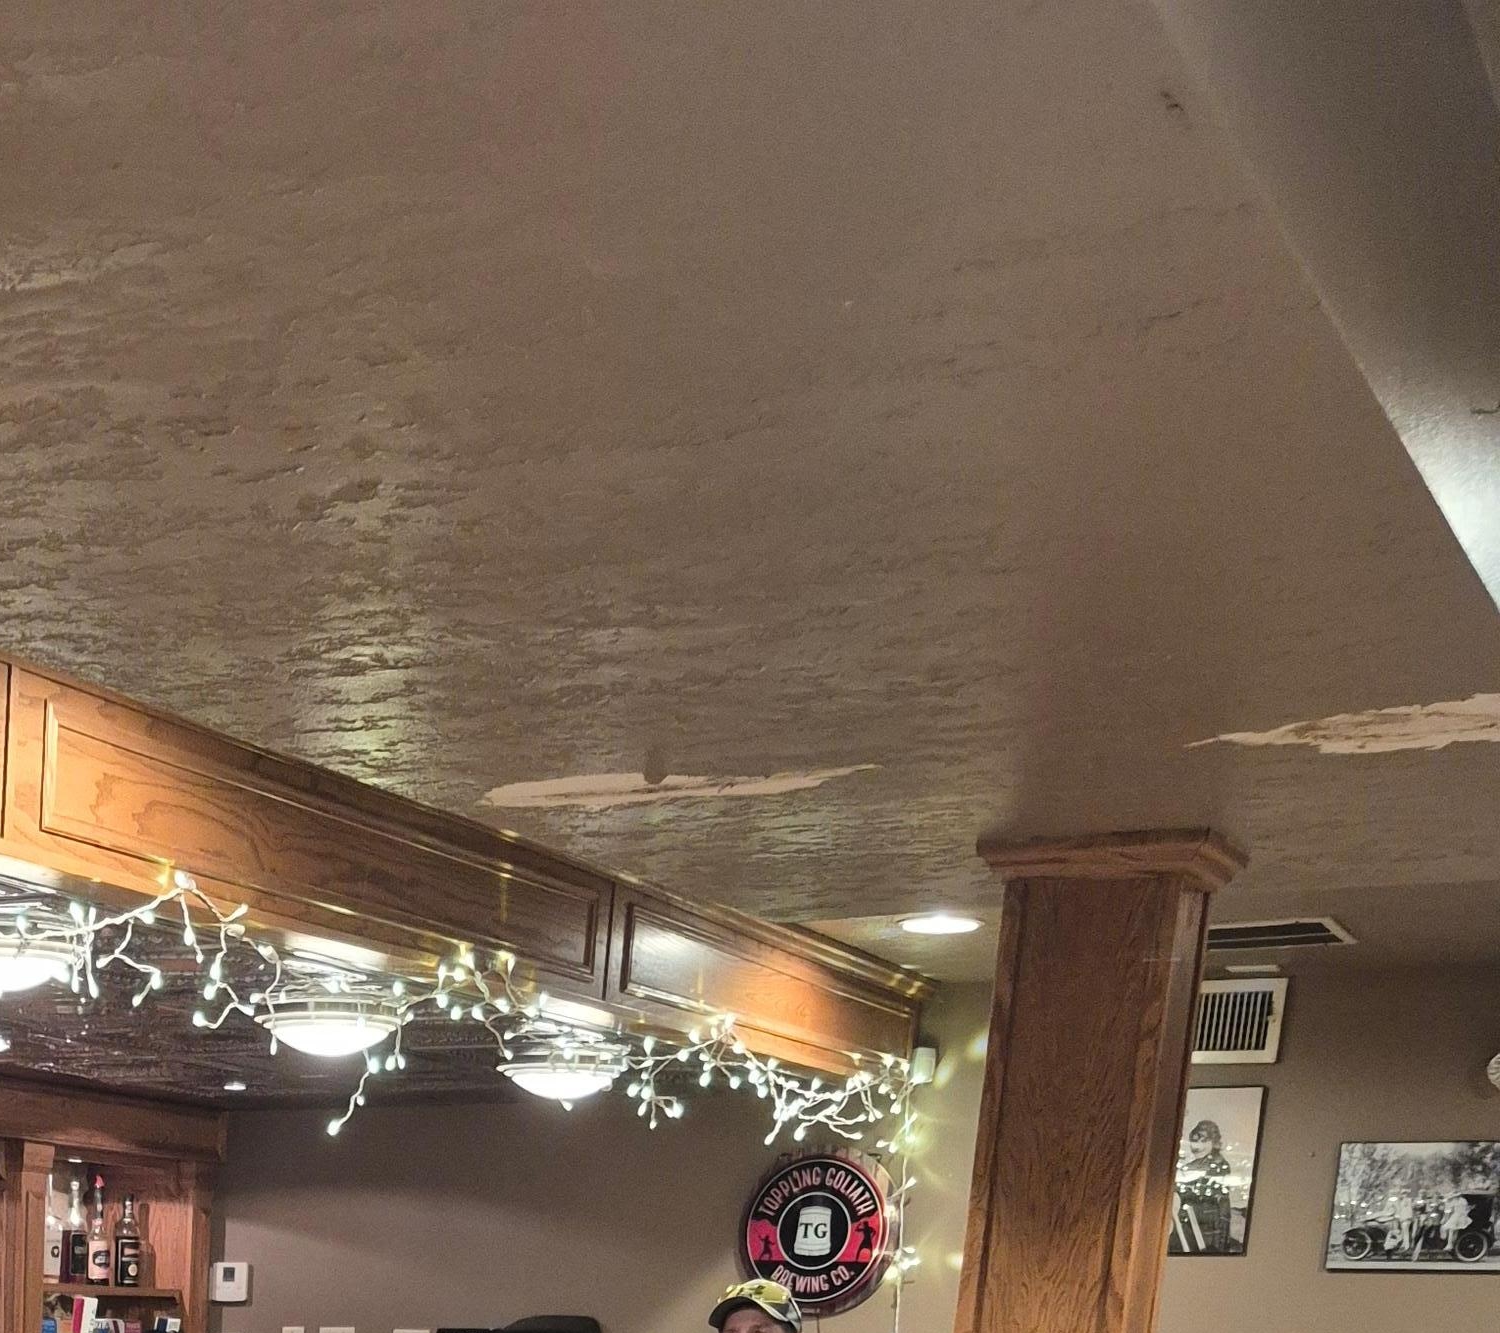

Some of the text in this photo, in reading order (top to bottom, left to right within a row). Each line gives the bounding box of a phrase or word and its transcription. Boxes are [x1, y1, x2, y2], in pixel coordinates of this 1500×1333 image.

[758, 1166, 876, 1216] TOPPLING GOLIATH
[799, 1222, 828, 1239] TG
[770, 1264, 855, 1293] BREWING CO.
